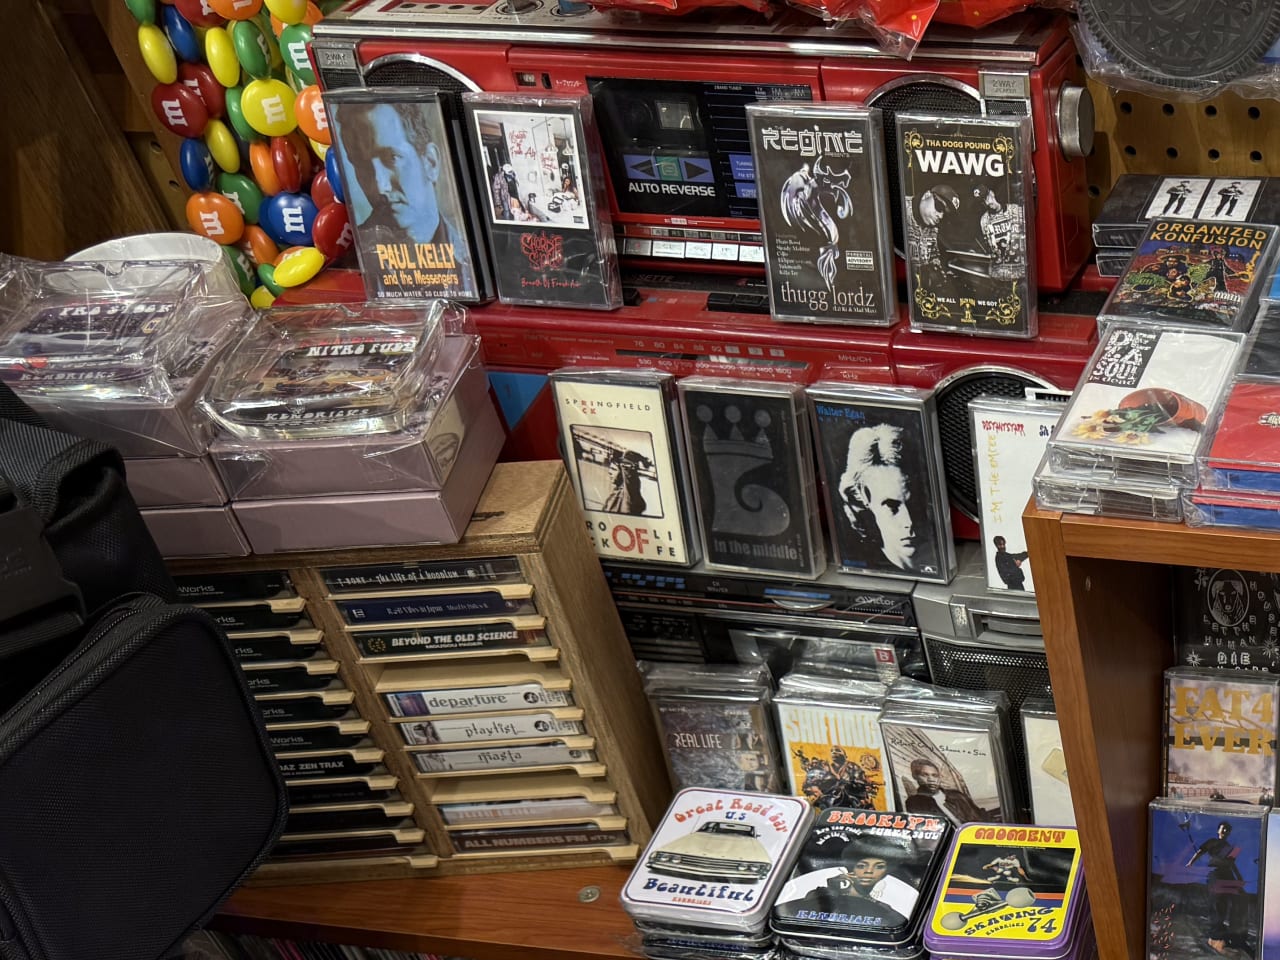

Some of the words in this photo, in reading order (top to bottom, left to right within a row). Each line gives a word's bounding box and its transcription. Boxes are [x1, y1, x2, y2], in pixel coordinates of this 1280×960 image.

[926, 140, 941, 148] THA
[942, 140, 963, 148] DOGG
[964, 141, 991, 150] POUND
[915, 150, 1005, 177] WAWG
[628, 182, 660, 195] AUTO
[662, 182, 716, 197] REVERSE
[1150, 231, 1263, 250] KONFUSION
[1156, 222, 1267, 241] ORGANIZED
[376, 243, 416, 270] PAUL
[416, 242, 457, 270] KELLY
[383, 272, 400, 286] and
[400, 272, 414, 286] the
[414, 271, 459, 290] Messengers
[781, 281, 828, 312] thugg
[832, 281, 875, 308] lordz
[565, 398, 651, 412] SPRINGFIELD
[612, 524, 651, 554] OF
[729, 540, 750, 554] the
[752, 544, 798, 561] middle
[392, 635, 432, 648] BEYOND
[434, 634, 452, 645] THE
[454, 633, 474, 644] OLD
[476, 630, 518, 643] SCIENCE
[429, 694, 508, 710] departure
[1174, 687, 1250, 722] FAT
[1251, 692, 1274, 723] 4
[465, 722, 517, 738] playlist
[702, 733, 722, 750] LIFE
[1173, 724, 1275, 756] EVER
[826, 811, 941, 830] BROOKLYN
[464, 838, 482, 848] ALL
[484, 836, 565, 846] NUMBERS
[974, 828, 1066, 844] MOMENT
[642, 878, 754, 902] Beautiful
[964, 907, 1055, 936] SKATING
[1026, 917, 1057, 934] 74
